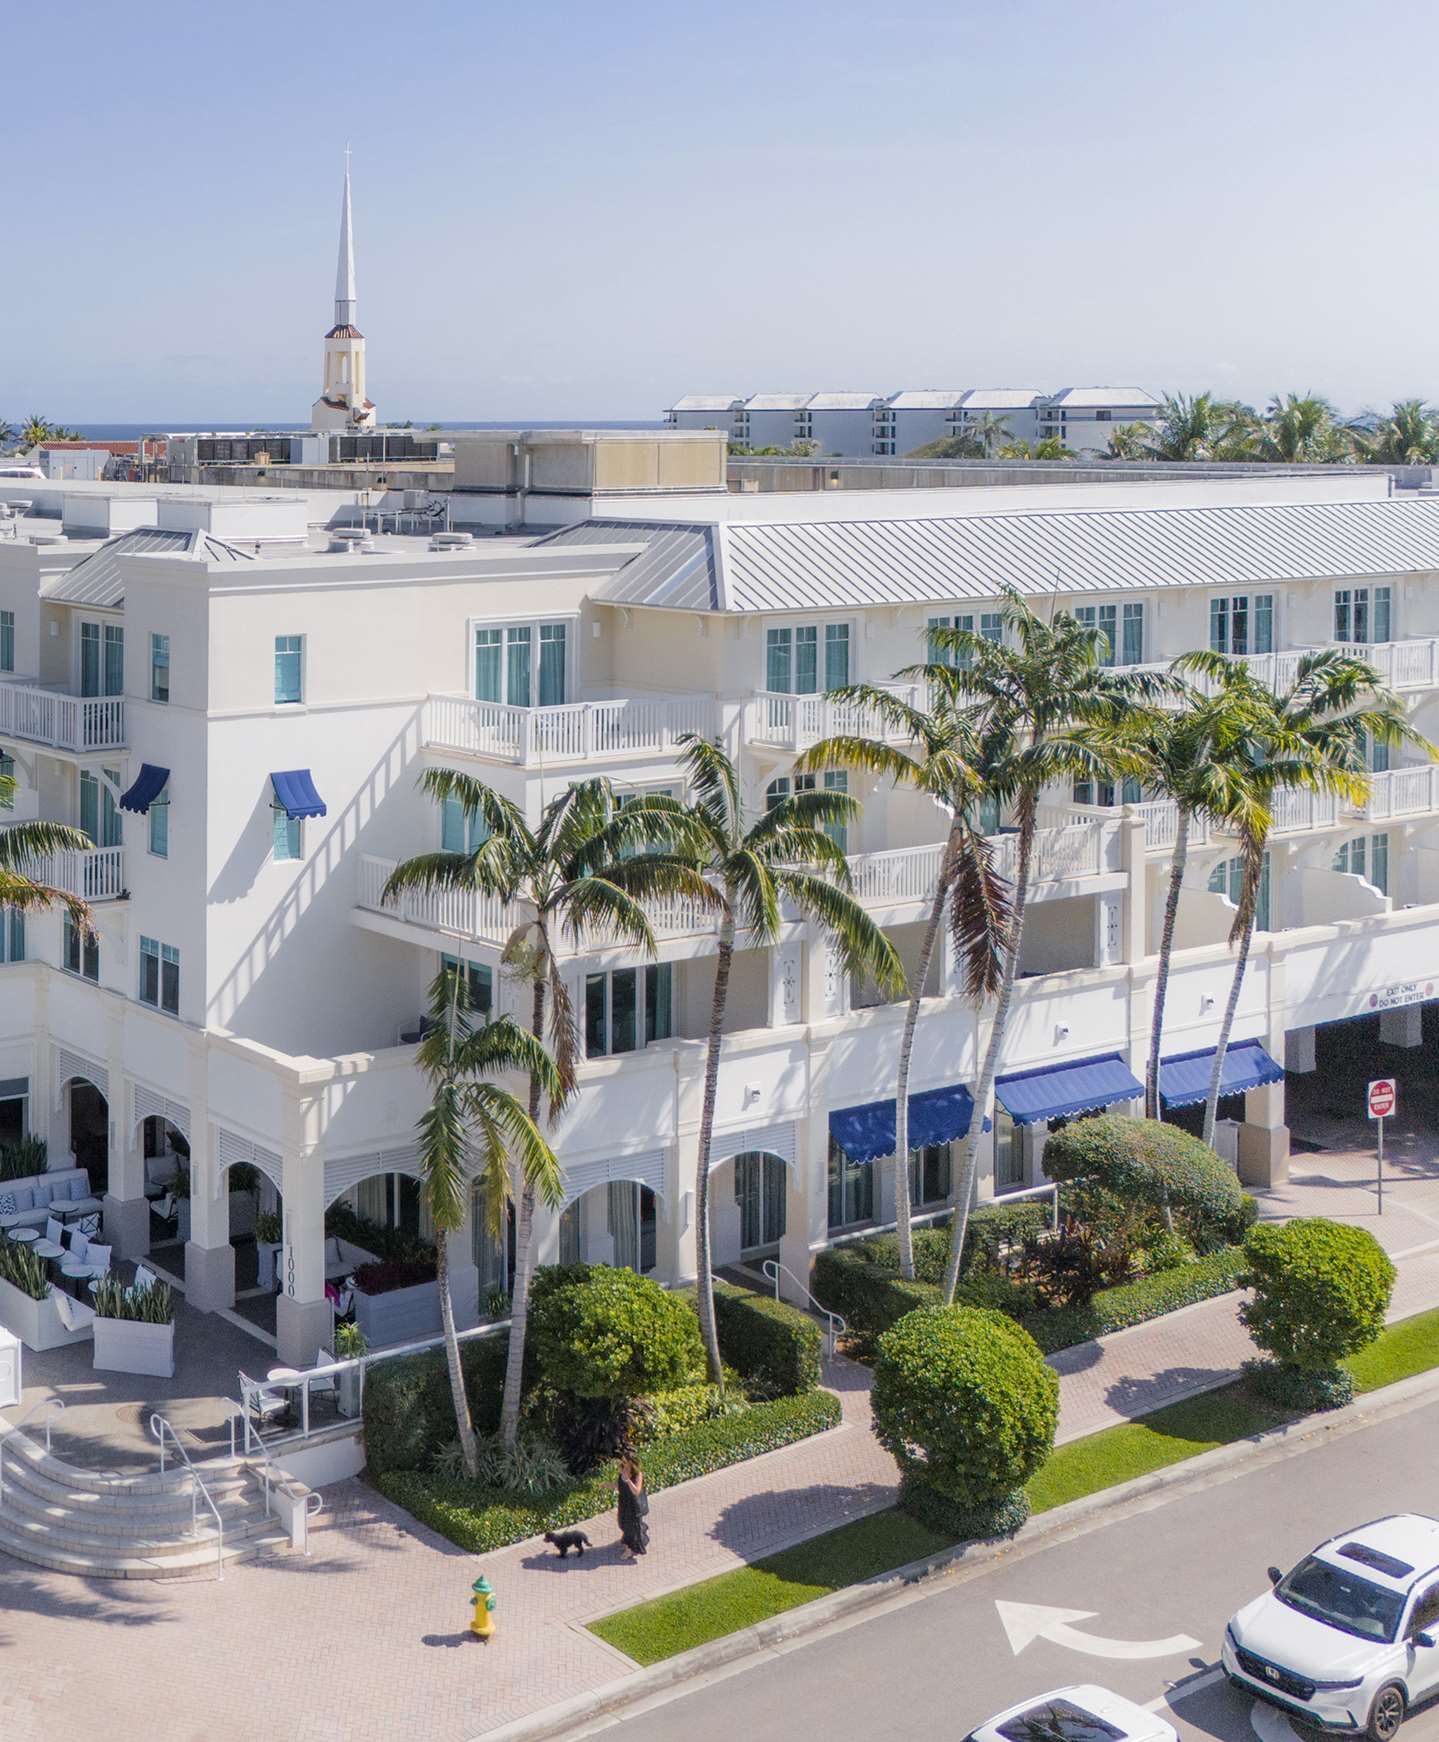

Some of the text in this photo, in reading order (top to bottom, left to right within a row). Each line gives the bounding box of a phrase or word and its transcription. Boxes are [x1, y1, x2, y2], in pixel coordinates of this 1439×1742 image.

[1386, 983, 1417, 997] EXIT ONLY
[1379, 991, 1424, 1008] DO NOT ENTER
[1373, 1102, 1390, 1110] ENTER
